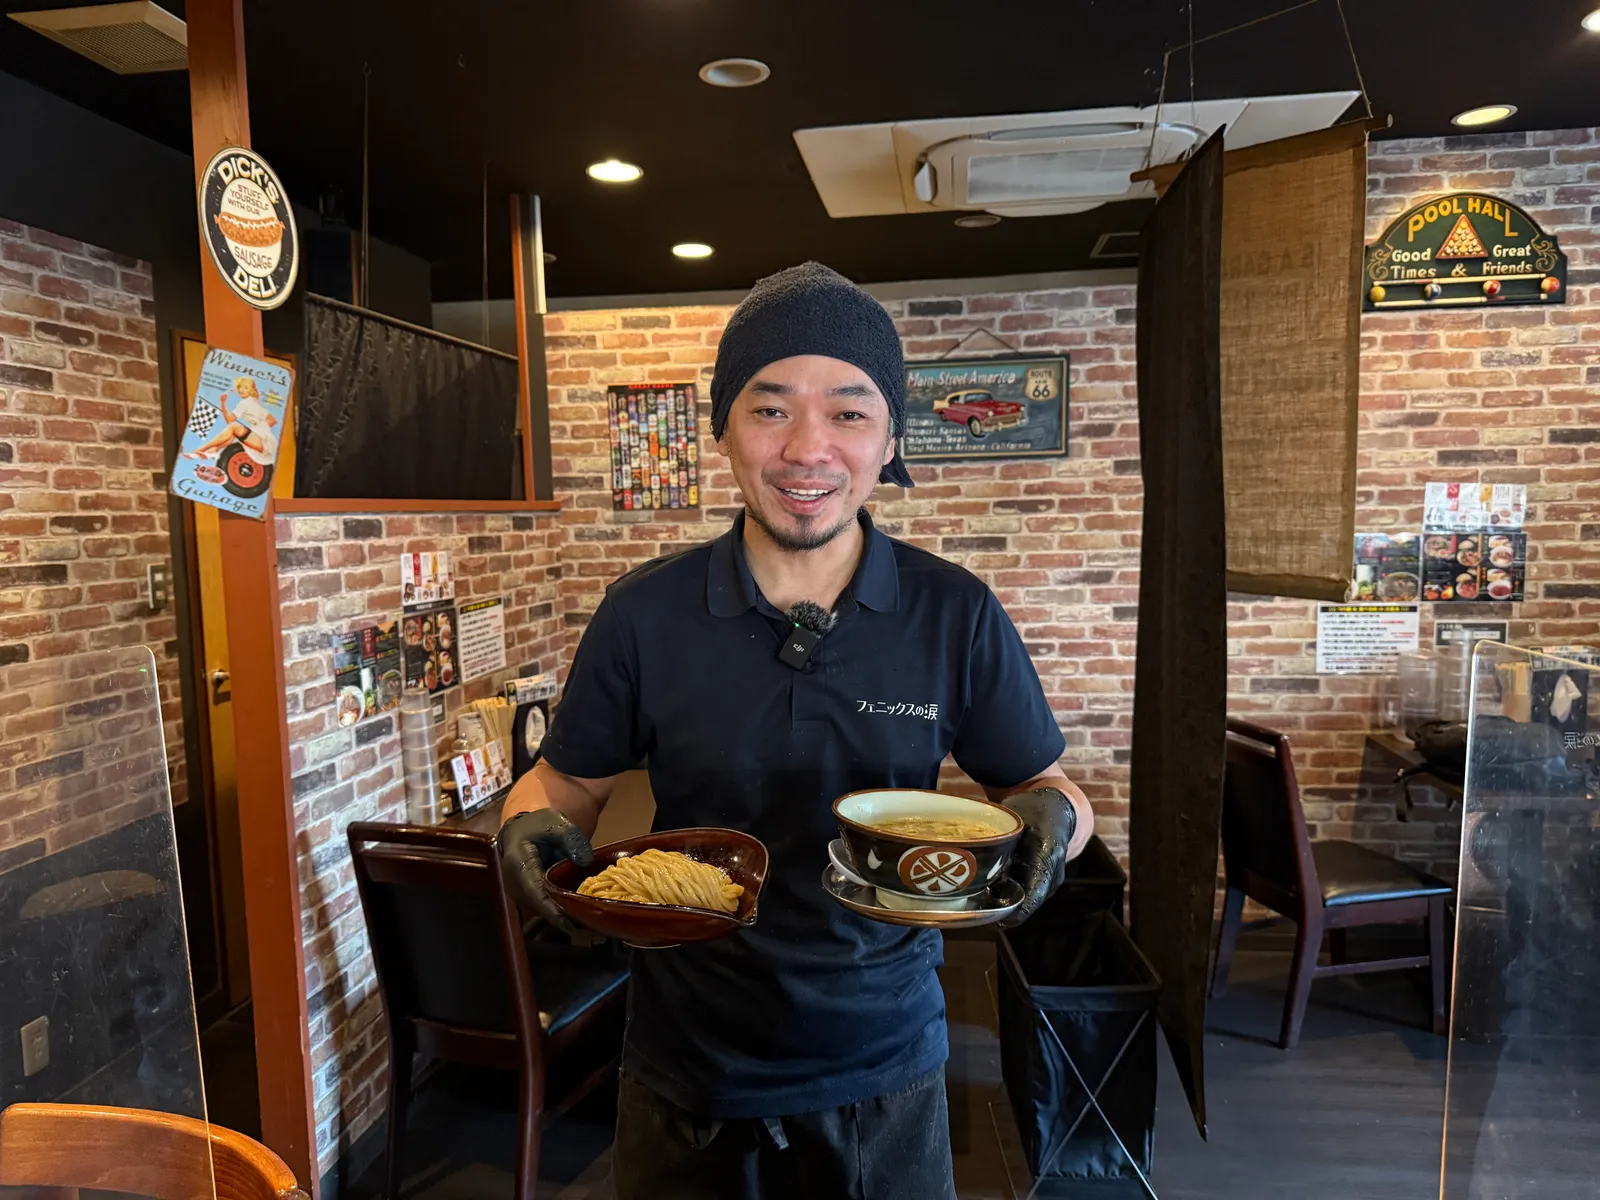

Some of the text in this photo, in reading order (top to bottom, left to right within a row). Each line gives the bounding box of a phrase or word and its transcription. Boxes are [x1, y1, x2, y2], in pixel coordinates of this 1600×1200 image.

[218, 157, 280, 204] DICK'S
[230, 188, 270, 211] YOURSELF
[237, 184, 262, 200] STUFF
[228, 199, 260, 216] WITH OUR
[1407, 198, 1519, 242] POOL HALL
[234, 246, 273, 270] SAUSAGE
[1391, 244, 1532, 262] Good Great
[1390, 261, 1534, 280] Times & Friends
[232, 266, 276, 298] DELI
[208, 350, 288, 387] Winner's
[907, 368, 1018, 387] Main Street America
[1032, 384, 1050, 398] 66
[177, 478, 260, 513] Garage
[856, 700, 938, 720] フェニックスの涙
